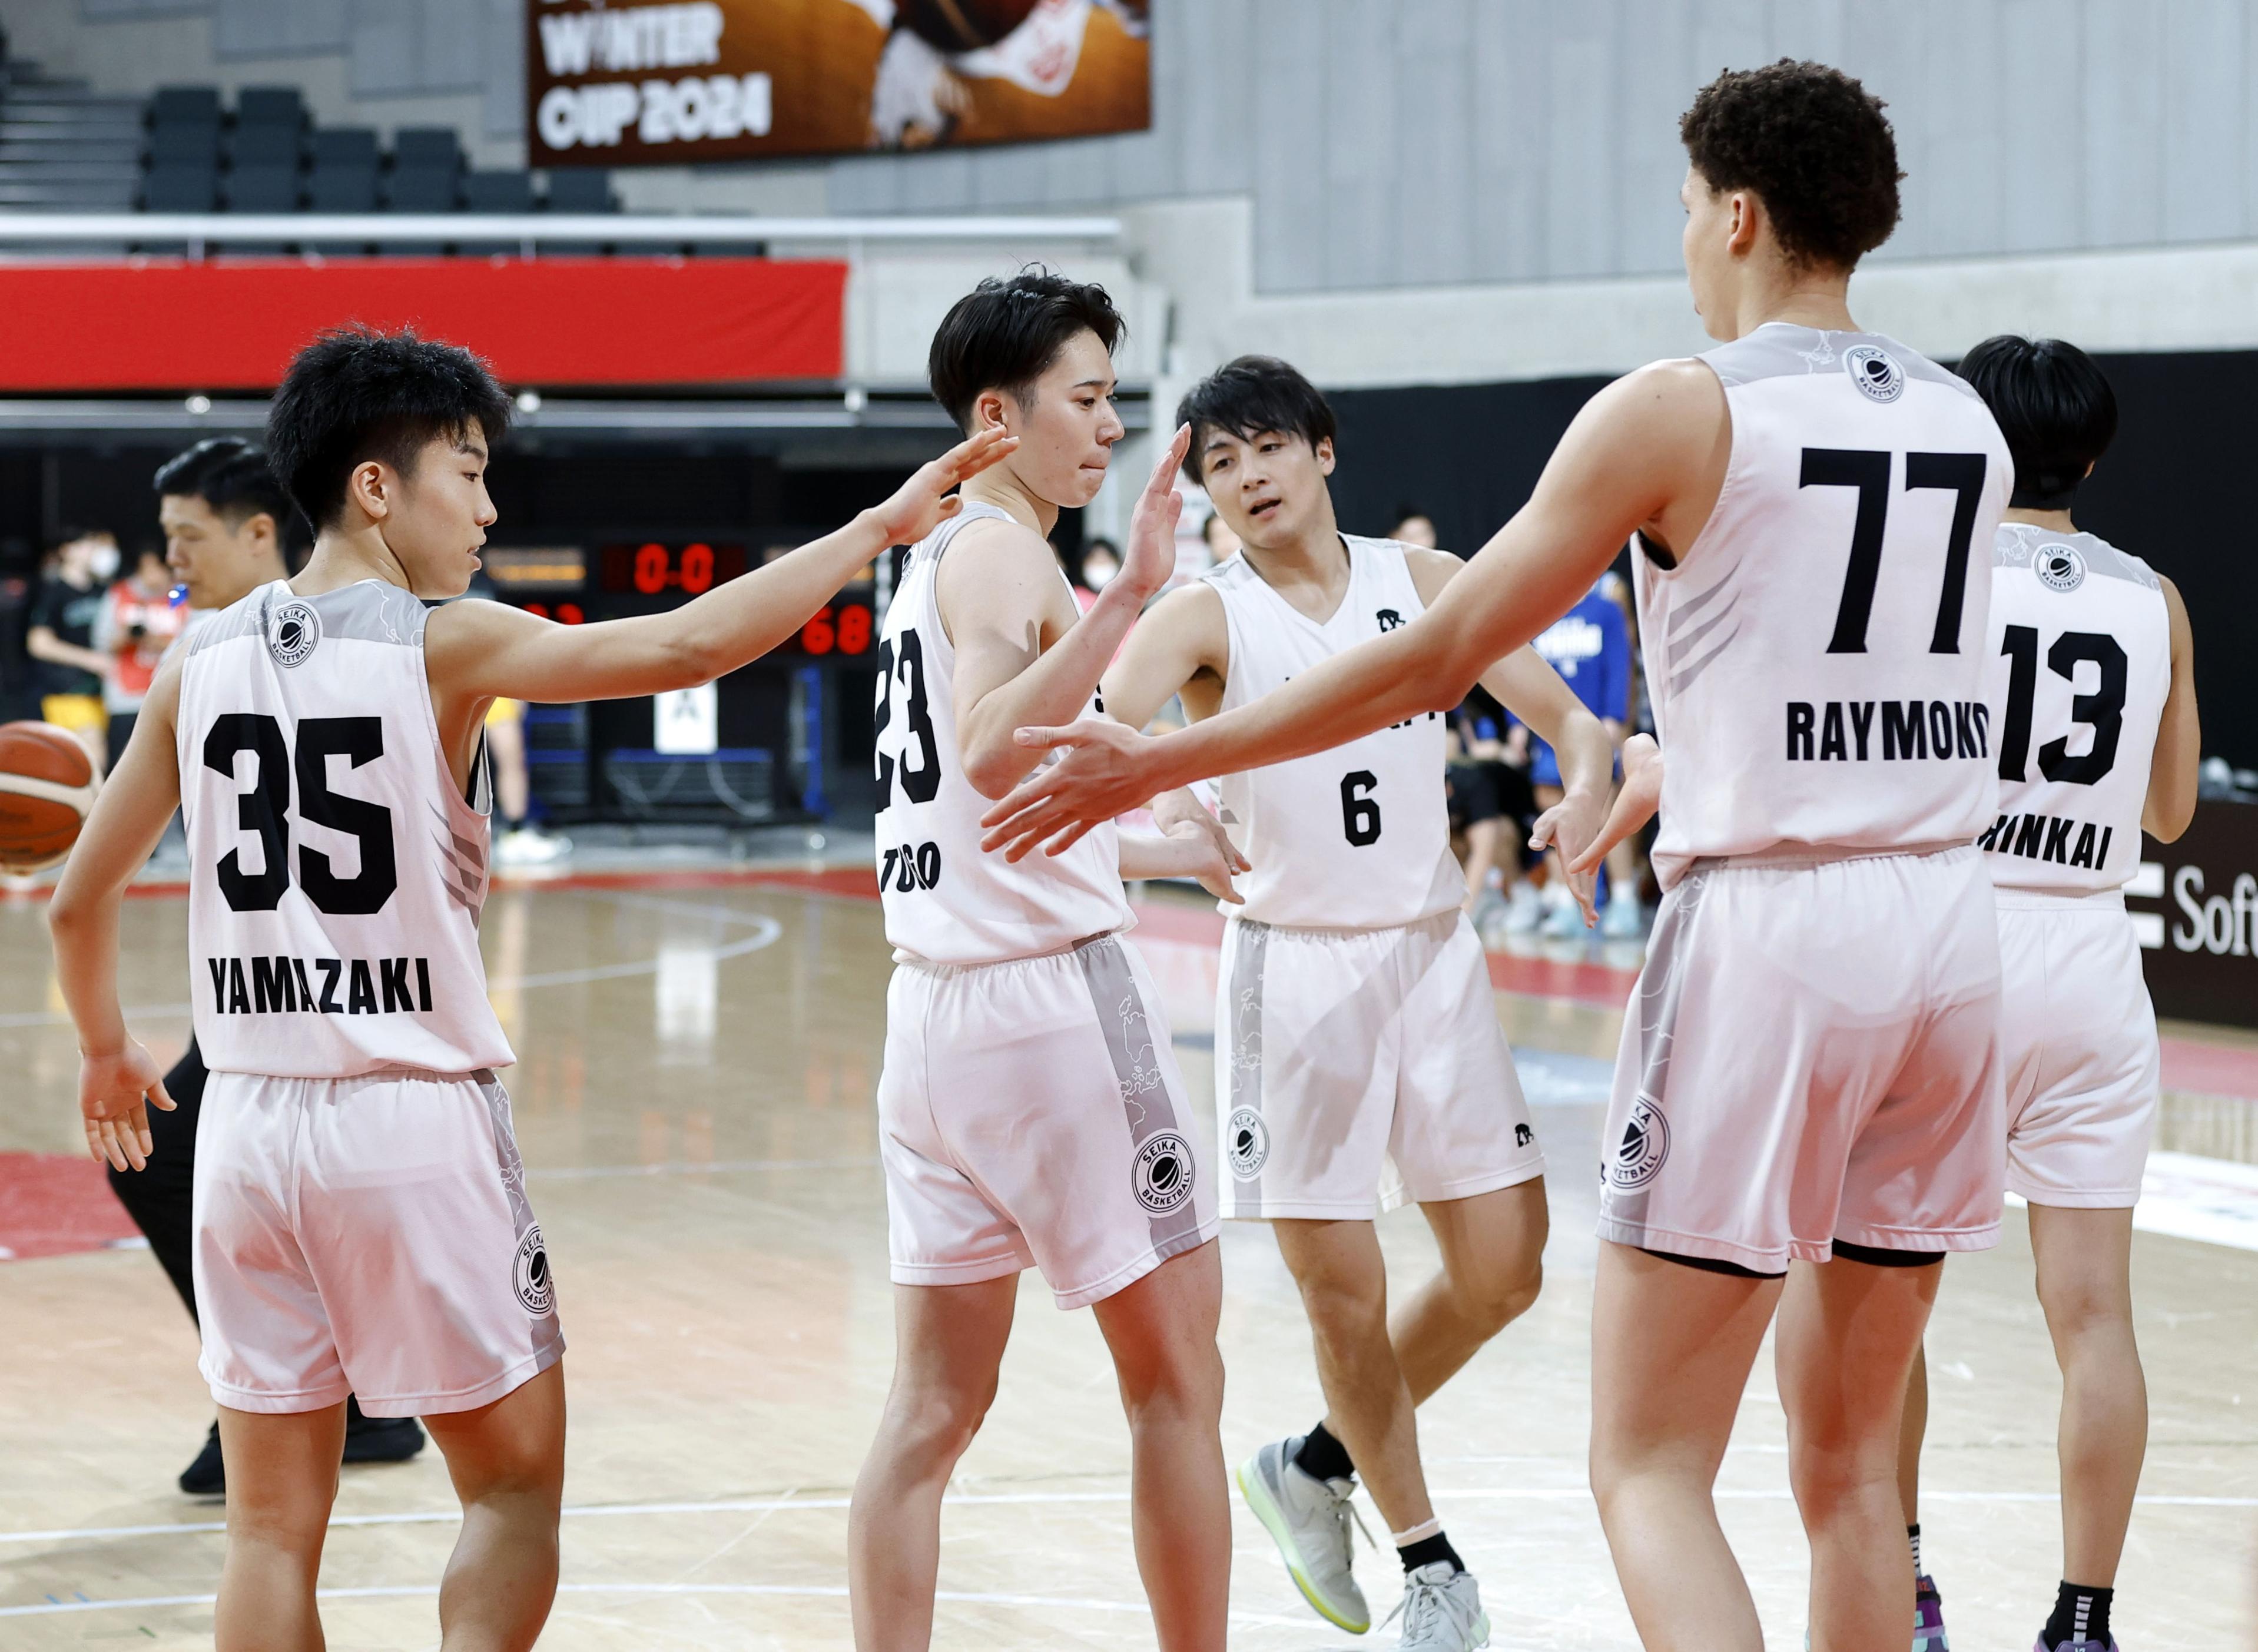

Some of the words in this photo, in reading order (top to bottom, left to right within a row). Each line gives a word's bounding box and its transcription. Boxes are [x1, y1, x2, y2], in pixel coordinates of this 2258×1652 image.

[538, 82, 638, 150] CUP
[639, 72, 772, 143] 2024
[634, 543, 714, 593] 0-0
[1799, 447, 1987, 655] 77
[277, 609, 306, 622] SEIKA
[801, 605, 873, 655] 68
[272, 641, 311, 662] BASKETBALL
[875, 628, 941, 814] 23
[1998, 624, 2128, 786] 13
[204, 714, 397, 914] 35
[1340, 769, 1381, 847] 6
[208, 956, 433, 1014] YAMAZAKI
[1143, 1140, 1176, 1163] SEIKA
[1142, 1169, 1191, 1205] BASKETBALL
